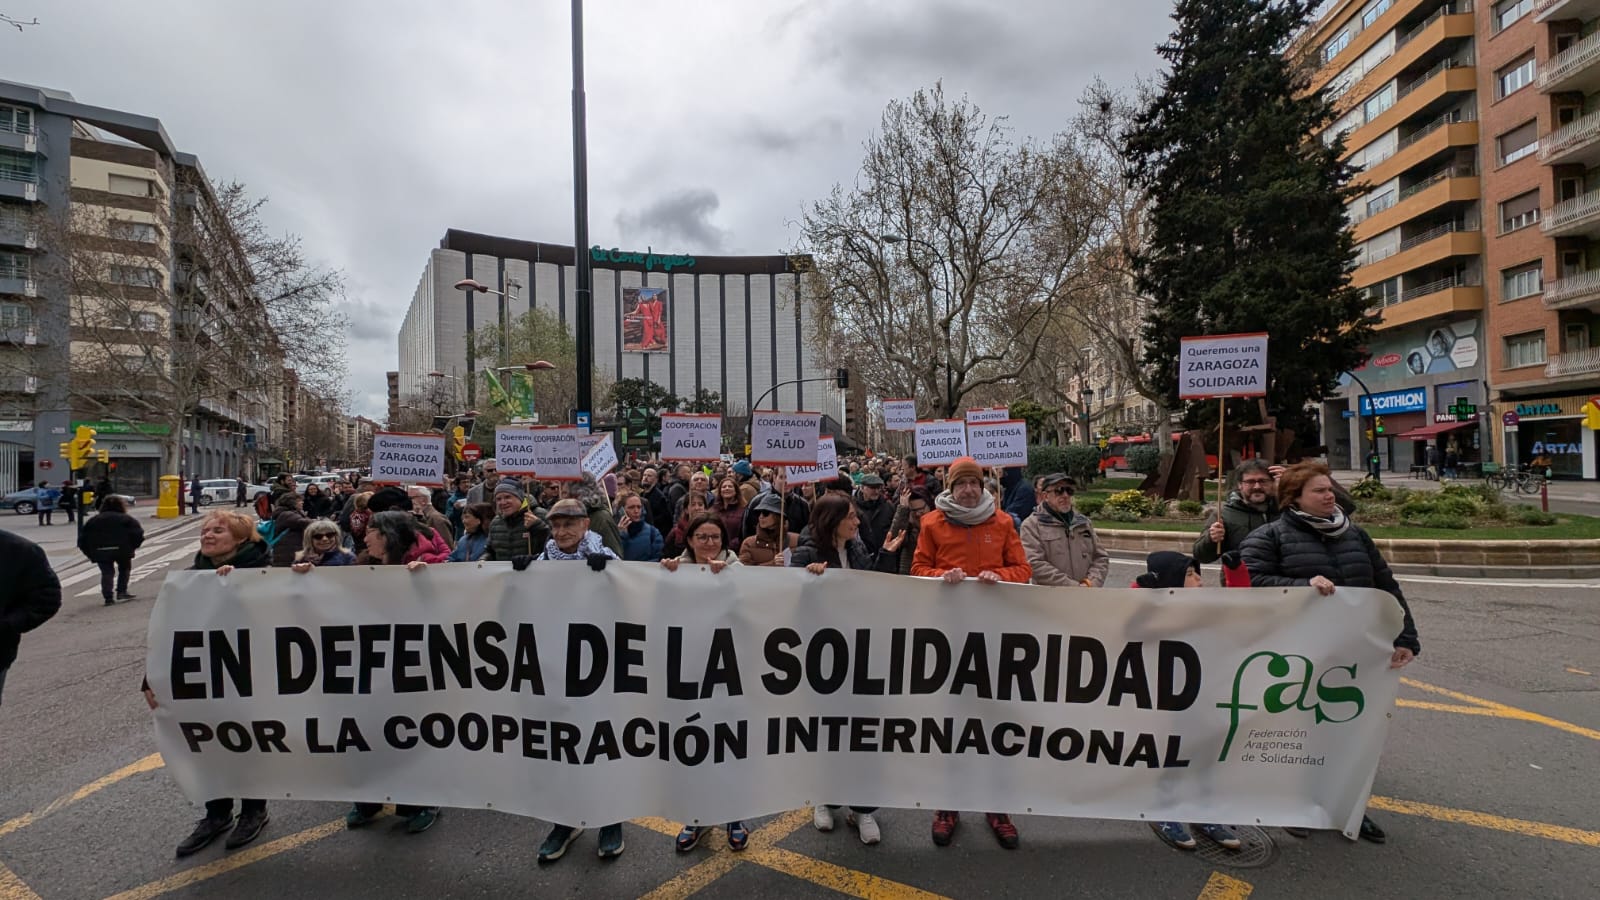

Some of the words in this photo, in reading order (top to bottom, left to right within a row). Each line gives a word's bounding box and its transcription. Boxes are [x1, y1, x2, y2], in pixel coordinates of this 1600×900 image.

[1188, 347, 1238, 356] Queremos
[1242, 345, 1260, 353] una
[1188, 359, 1259, 372] ZARAGOZA
[1188, 376, 1258, 388] SOLIDARIA
[1366, 392, 1423, 410] DECATHLON
[666, 421, 718, 430] COOPERACIÓN
[758, 418, 816, 428] COOPERACIÓN
[500, 434, 532, 442] Querem
[974, 430, 984, 438] EN
[986, 429, 1021, 438] DEFENSA
[380, 440, 421, 450] Queremos
[676, 439, 706, 449] AGUA
[766, 438, 805, 450] SALUD
[920, 438, 962, 446] ZARAGOZA
[500, 445, 533, 453] ZARAG
[380, 452, 438, 464] ZARAGOZA
[922, 450, 962, 459] SOLIDARIA
[973, 452, 1024, 460] SOLIDARIDAD
[502, 458, 534, 466] SOLIDA
[536, 457, 578, 465] SOLIDARIDAD
[380, 466, 436, 477] SOLIDARIA
[790, 460, 834, 475] VALORES
[171, 629, 252, 699] EN
[276, 621, 545, 696] DEFENSA
[566, 622, 647, 698] DE
[667, 627, 743, 700] LA
[761, 628, 1201, 711] SOLIDARIDAD
[1216, 651, 1365, 762] fas
[1248, 728, 1307, 738] Federación
[179, 720, 291, 753] POR
[306, 718, 371, 753] LA
[384, 712, 747, 766] COOPERACIÓN
[768, 717, 1190, 768] INTERNACIONAL
[1244, 740, 1303, 750] Aragonesa
[1241, 754, 1255, 762] de
[1260, 753, 1325, 766] Solidaridad
